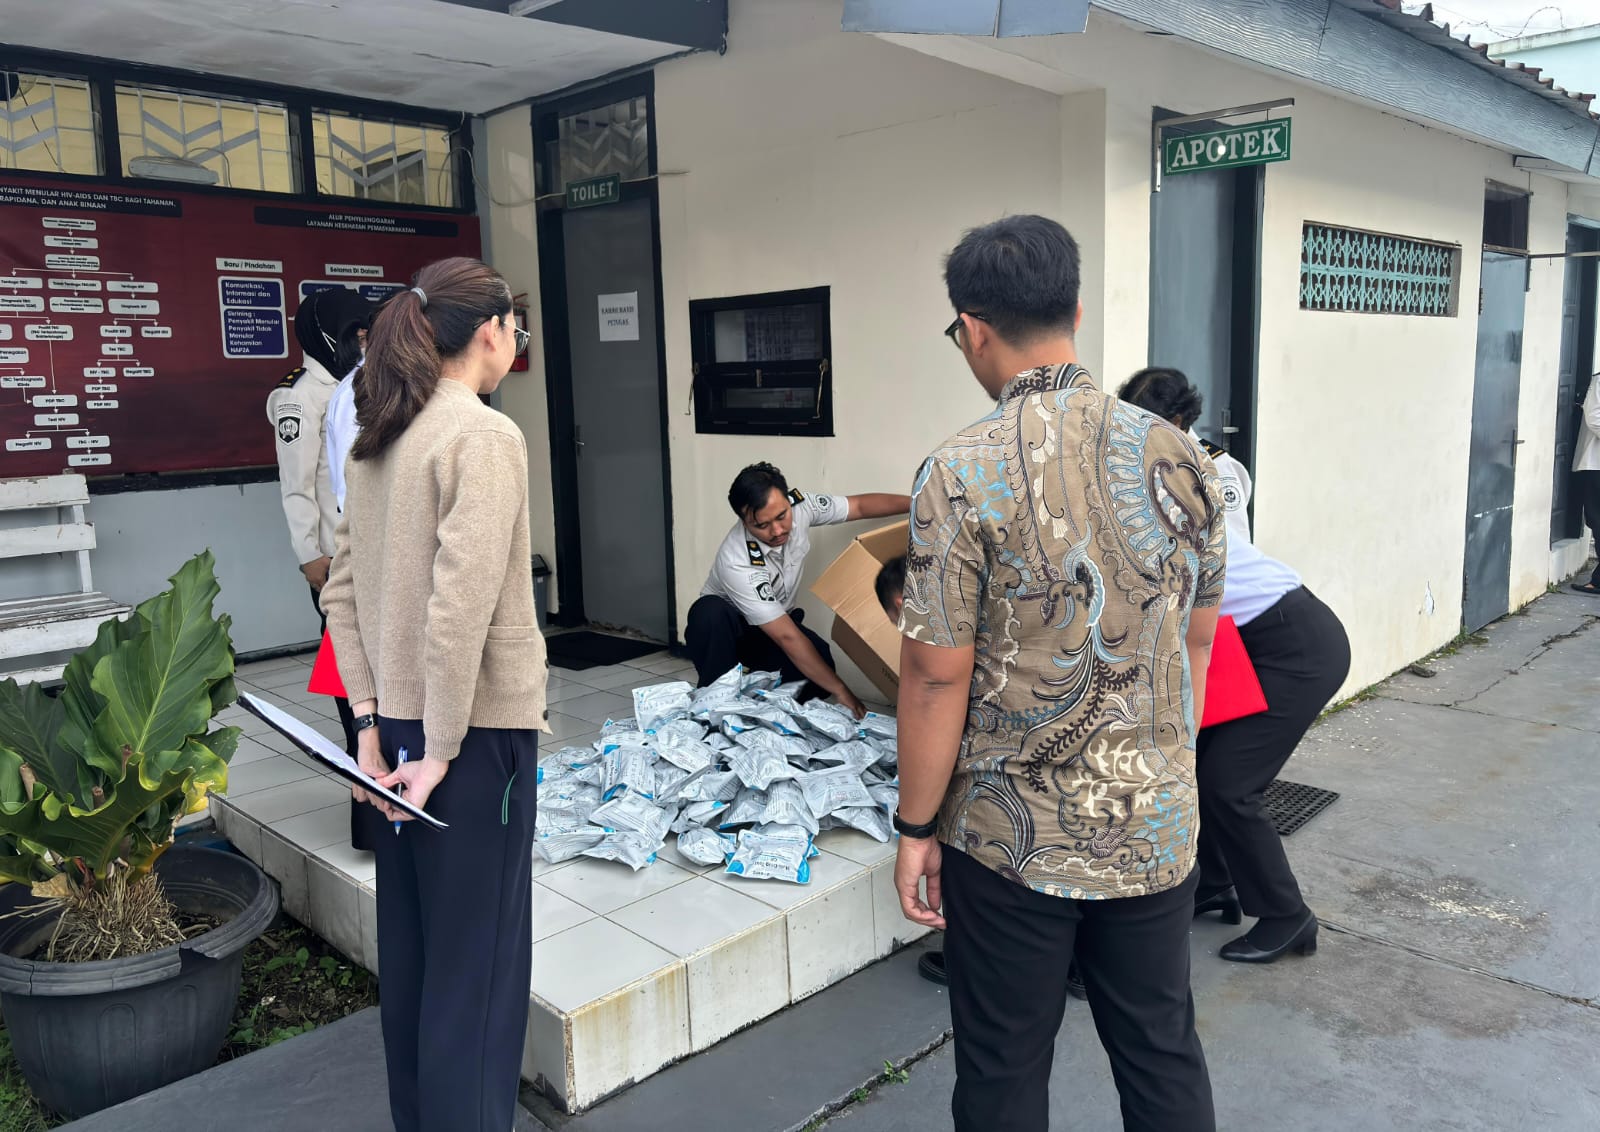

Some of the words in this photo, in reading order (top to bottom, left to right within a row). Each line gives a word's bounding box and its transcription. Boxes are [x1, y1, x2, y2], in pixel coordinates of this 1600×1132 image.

[1171, 127, 1282, 168] APOTEK
[25, 188, 59, 197] MENULAR
[61, 192, 91, 200] HIV-AIDS
[571, 181, 614, 202] TOILET
[80, 200, 106, 209] BINAAN
[306, 220, 333, 228] LAYANAN
[244, 262, 276, 270] Pindahan
